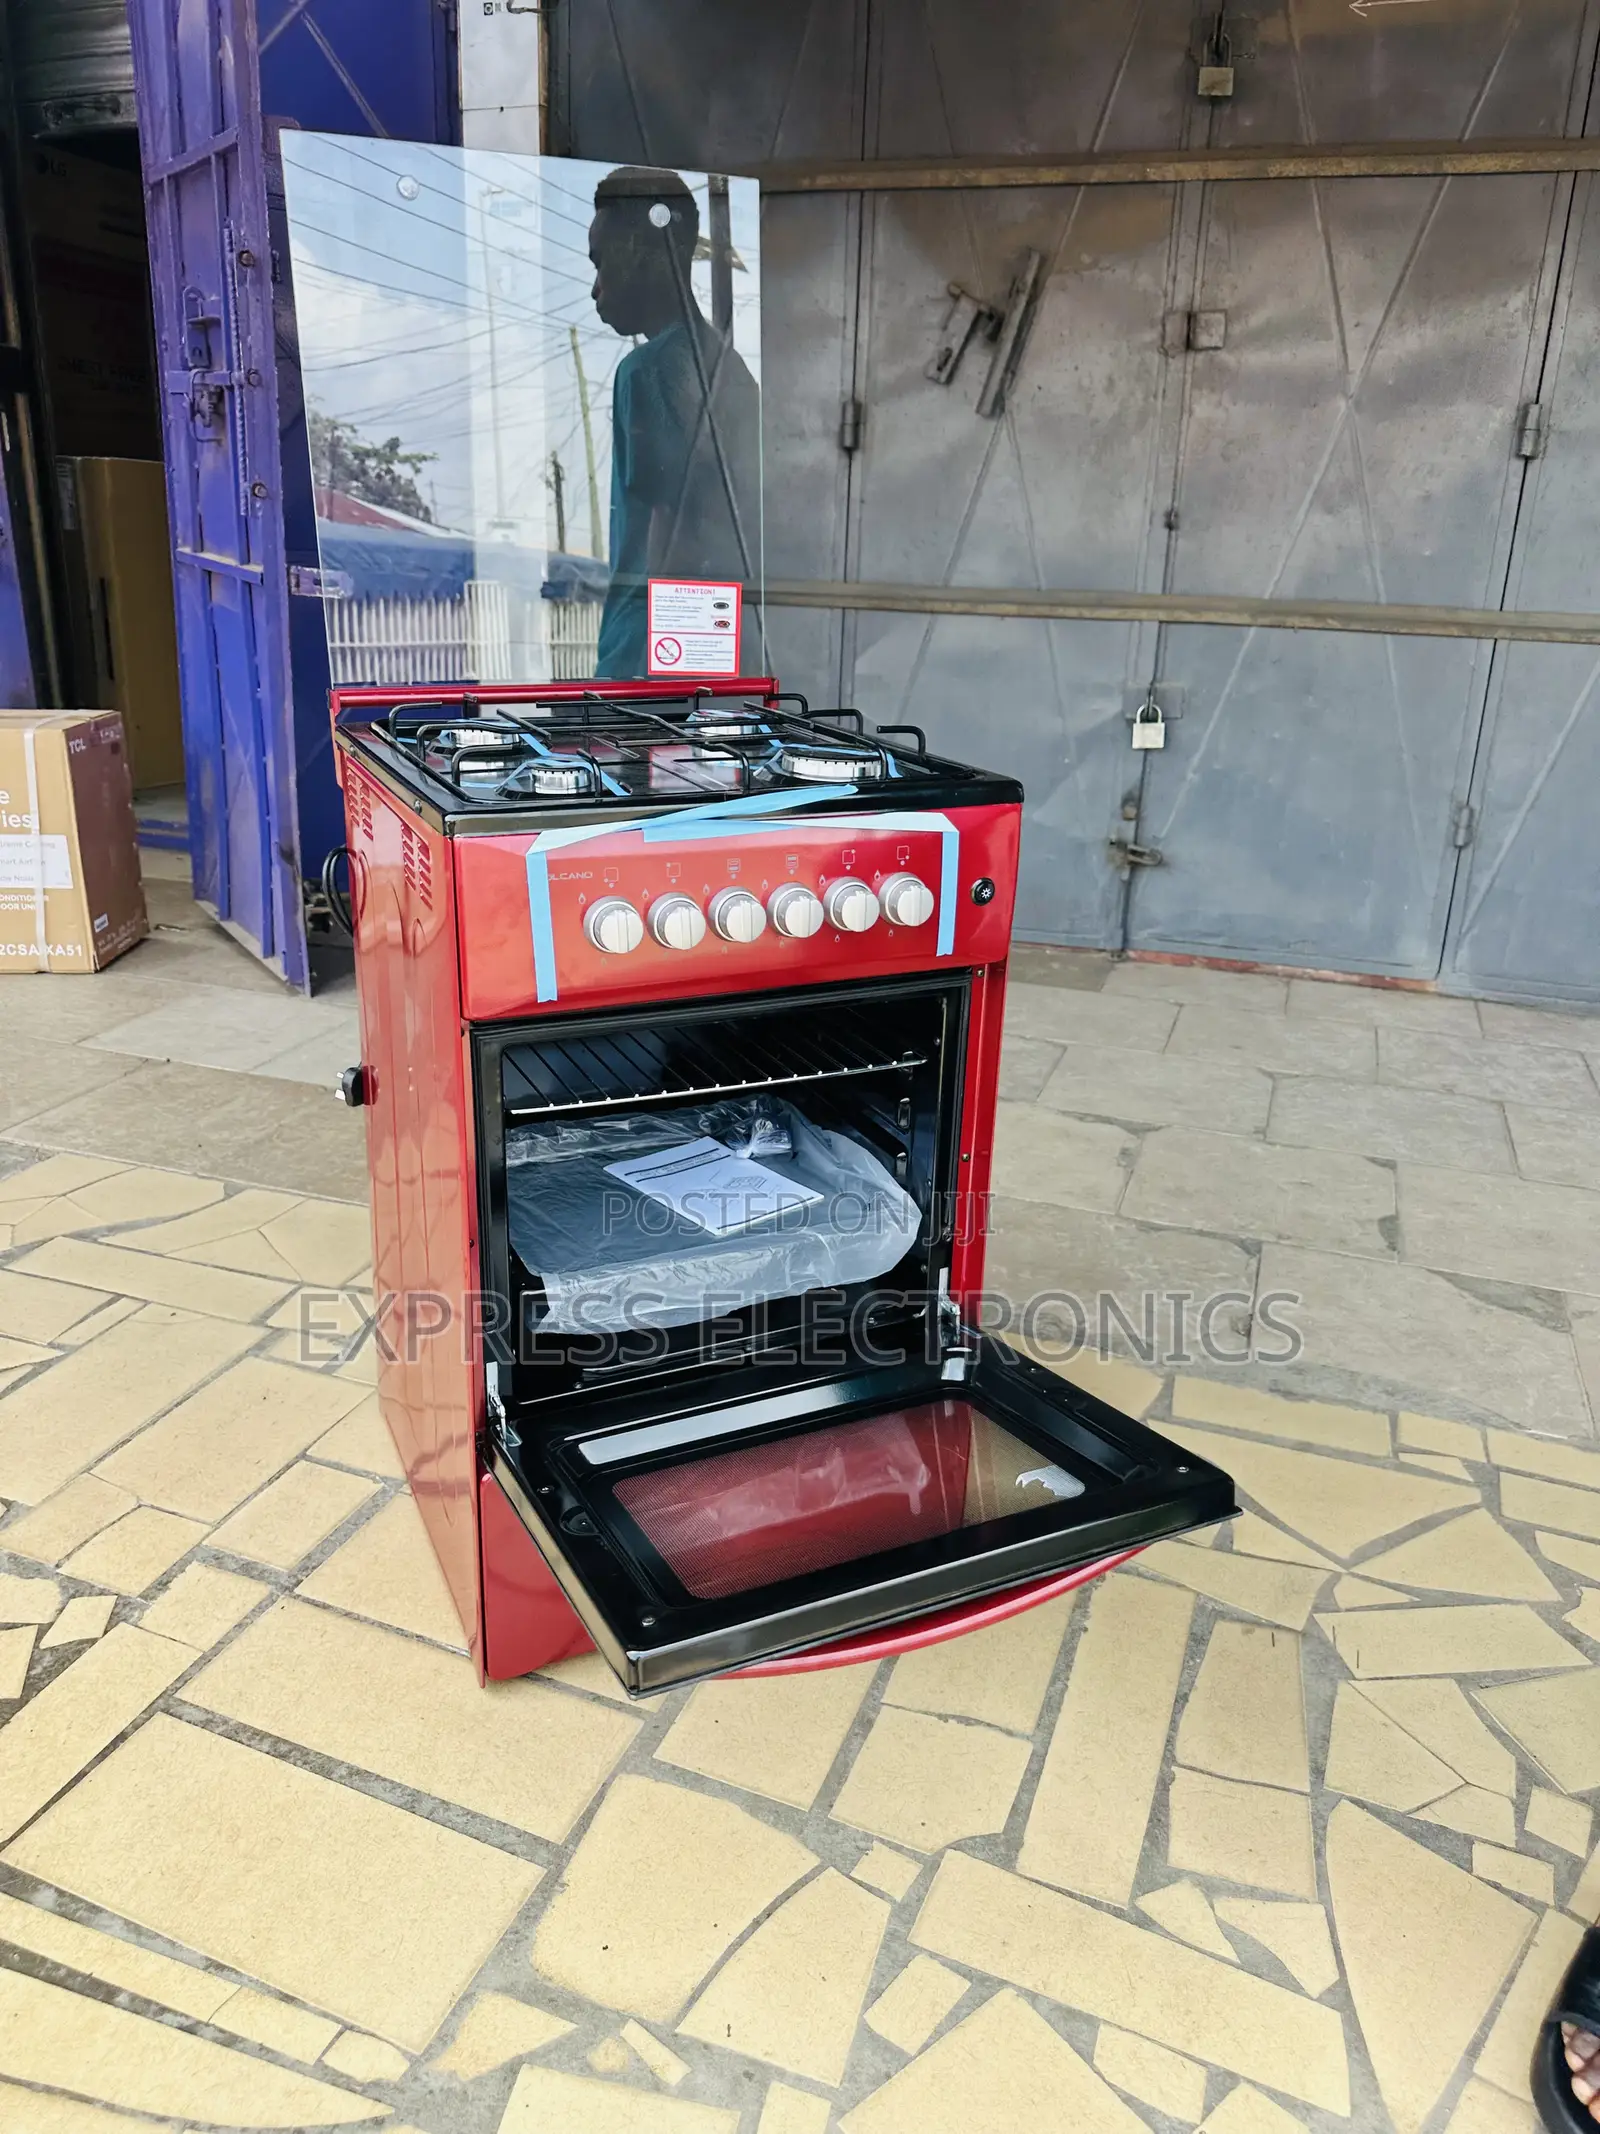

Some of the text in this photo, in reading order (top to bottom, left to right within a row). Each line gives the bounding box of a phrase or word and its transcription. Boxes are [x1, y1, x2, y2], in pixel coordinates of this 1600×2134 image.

[69, 738, 87, 754] TCL
[0, 809, 32, 828] ies
[0, 943, 82, 957] 2CSAXA51
